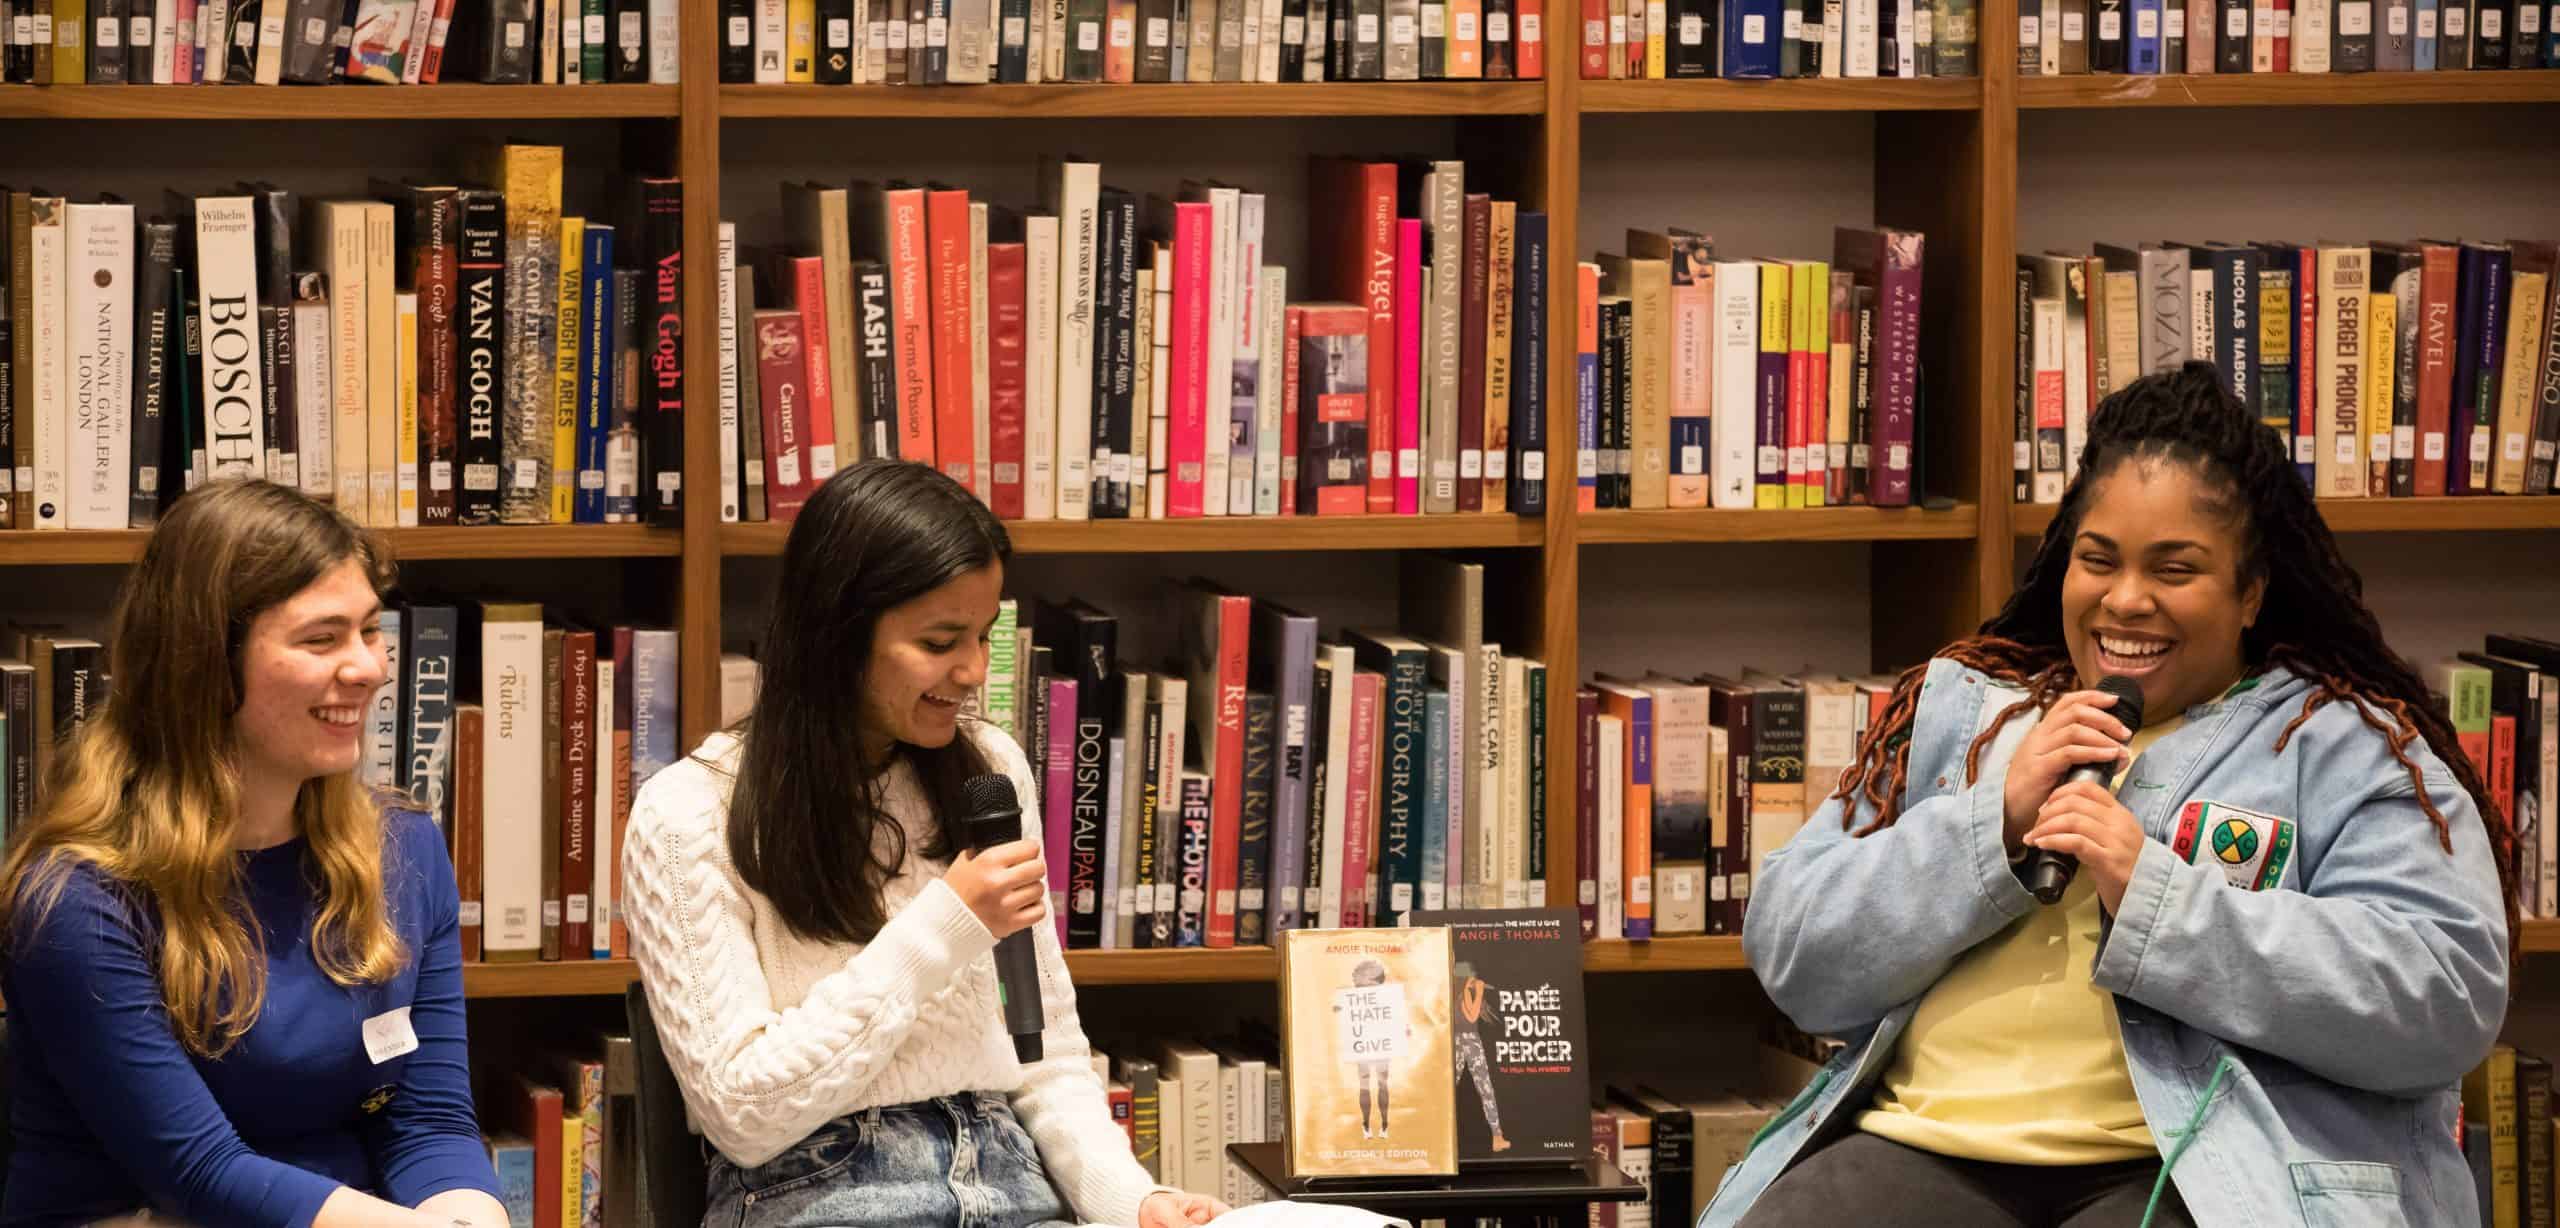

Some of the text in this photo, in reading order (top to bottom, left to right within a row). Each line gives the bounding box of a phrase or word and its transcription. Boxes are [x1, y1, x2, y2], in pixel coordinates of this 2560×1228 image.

[466, 229, 499, 238] Vincent
[719, 239, 735, 263] The
[1368, 195, 1395, 322] Eugène Atget
[1472, 213, 1484, 255] ATGET
[1531, 244, 1539, 270] PARIS
[424, 196, 449, 323] Vincent van Gogh
[1439, 172, 1457, 389] PARIS MON AMOUR
[524, 257, 541, 348] COMPLETE
[719, 269, 735, 305] Lives
[1118, 285, 1132, 319] Paris,
[2234, 260, 2246, 329] NICOLAS
[187, 318, 199, 353] BOSCH
[277, 307, 290, 366] BOSCH
[652, 251, 682, 411] Van Gogh I
[720, 321, 736, 353] LEE
[862, 274, 887, 358] FLASH
[898, 206, 922, 439] Edward Weston Forms of Passion
[2204, 291, 2214, 341] Mozart's
[2426, 302, 2449, 372] RAVEL
[97, 302, 112, 391] NATIONAL
[145, 308, 167, 418] THE LOUVRE
[266, 328, 277, 414] Hieronymus Bosch
[335, 282, 360, 417] Vincent van Gogh
[470, 275, 492, 440] VAN GOGH
[523, 353, 538, 387] VAN
[559, 269, 580, 428] VAN GOGH IN ARLES
[1117, 329, 1130, 363] Ronis
[1858, 309, 1873, 409] modern music
[1889, 286, 1904, 424] WESTERN MUSIC
[1904, 293, 1916, 416] A HISTORY OF
[2335, 296, 2359, 437] SERGEI PROKOFI
[2404, 331, 2413, 369] RAVEL
[78, 354, 92, 430] LONDON
[209, 292, 254, 467] BOSCH
[720, 365, 737, 426] MILLER
[1115, 363, 1131, 394] Willy
[1493, 358, 1506, 399] PARIS
[521, 390, 538, 441] GOGH
[780, 383, 797, 444] Camera
[637, 648, 654, 684] Karl
[73, 670, 88, 720] Vermeer
[500, 665, 520, 741] Rubens
[989, 682, 1015, 712] THE
[1217, 685, 1246, 731] Ray
[1412, 664, 1426, 734] The ART of
[1487, 650, 1499, 770] CORNELL CAPA
[1768, 704, 1798, 713] MUSIC
[568, 720, 590, 761] Dyck
[617, 743, 630, 774] VAN
[1389, 663, 1414, 858] PHOTOGRAPHY
[571, 767, 583, 795] van
[1074, 724, 1102, 852] DOISNEAU
[1165, 733, 1176, 805] anonymous
[1243, 706, 1273, 842] MAN RAY
[567, 800, 585, 862] Antoine
[1144, 796, 1157, 837] Flower
[1142, 854, 1154, 874] the
[1143, 839, 1154, 851] in
[1459, 929, 1560, 942] ANGIE THOMAS
[1544, 919, 1560, 927] GIVE
[1326, 944, 1361, 953] ANGIE
[1345, 992, 1377, 1006] THE
[1350, 1006, 1392, 1022] HATE
[1499, 983, 1561, 1011] PARÉE
[1352, 1024, 1363, 1038] U
[1353, 1038, 1392, 1054] GIVE
[1504, 1014, 1561, 1037] POUR
[1496, 1040, 1572, 1062] PERCER
[1193, 1079, 1211, 1163] NADAR
[1386, 1149, 1429, 1159] EDITION
[566, 1149, 580, 1228] aboriginali
